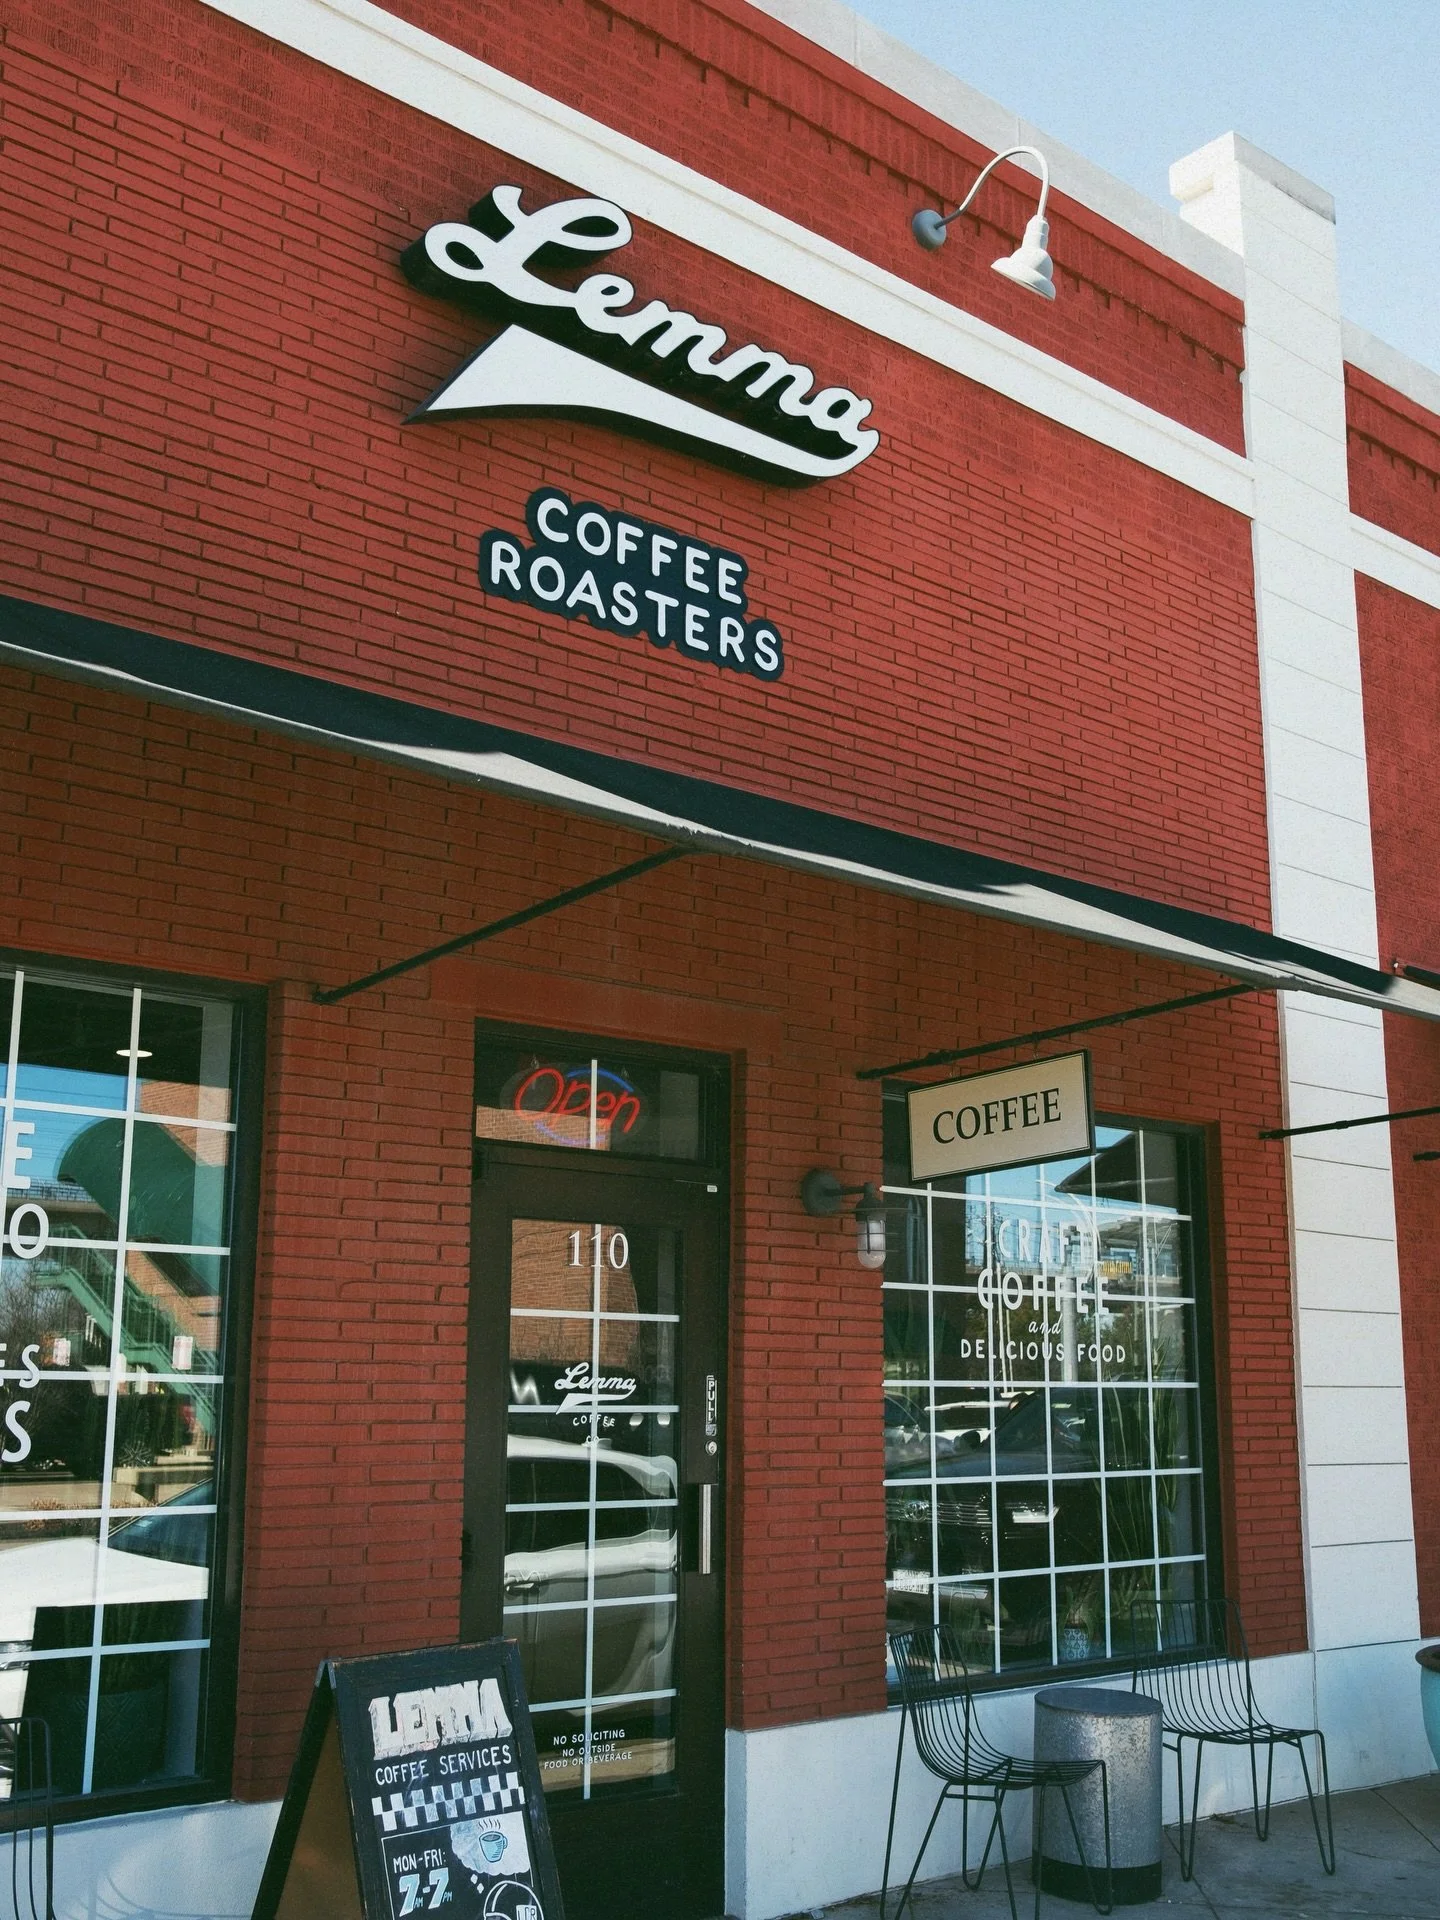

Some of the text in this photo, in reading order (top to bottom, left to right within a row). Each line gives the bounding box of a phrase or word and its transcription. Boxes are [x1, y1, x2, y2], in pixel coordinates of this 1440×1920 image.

[424, 184, 881, 477] Lemma
[536, 497, 743, 605] COFFEE
[490, 540, 780, 672] ROASTERS
[514, 1067, 640, 1134] Open
[932, 1087, 1062, 1144] COFFEE
[567, 1230, 629, 1269] 110
[998, 1218, 1094, 1266] CRAFT
[977, 1268, 1110, 1314] COFFEE
[1028, 1313, 1063, 1335] and
[960, 1339, 1127, 1364] DELICIOUS FOOD
[554, 1362, 637, 1405] Lemma
[572, 1414, 616, 1428] COFFEE
[553, 1729, 626, 1746] NO SOLICITING
[562, 1743, 616, 1757] NO OUTSIDE
[375, 1744, 512, 1786] COFFEE SERVICES
[544, 1751, 633, 1770] FOOD OR BEVERAGE
[393, 1848, 447, 1873] MON-FRI:
